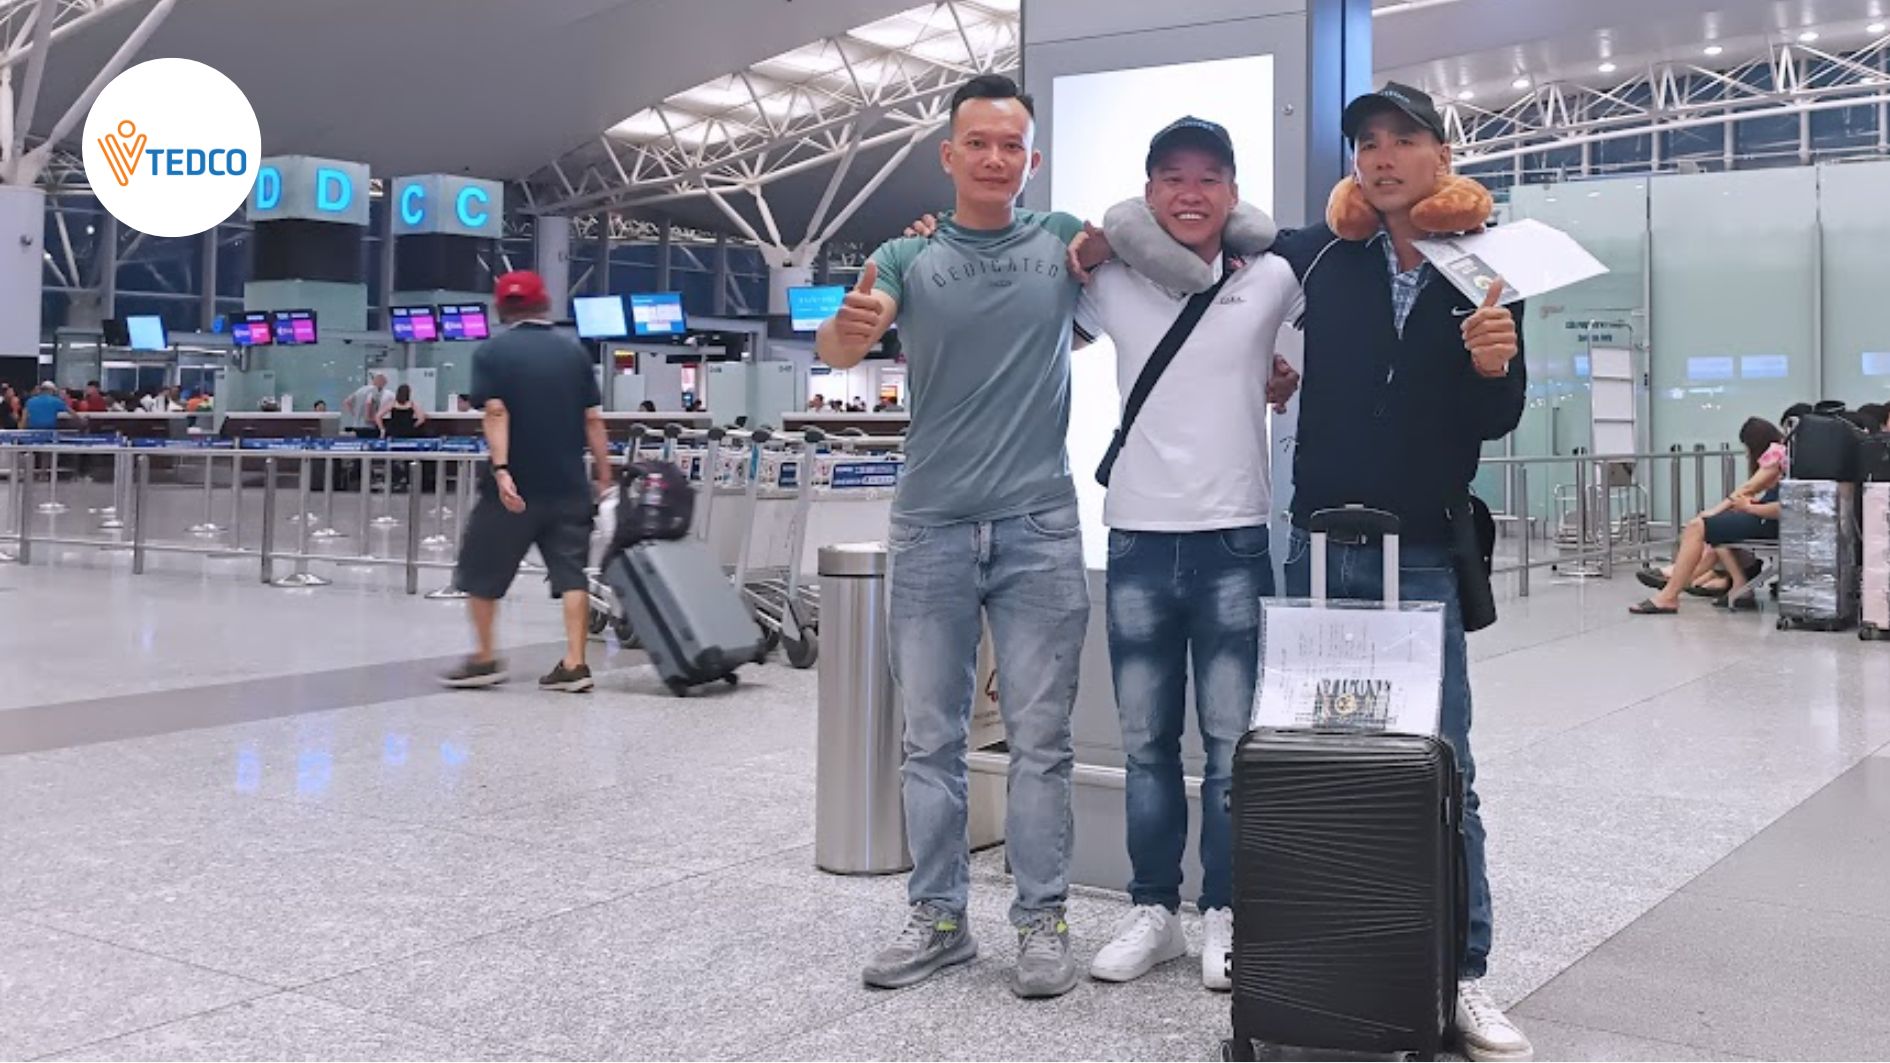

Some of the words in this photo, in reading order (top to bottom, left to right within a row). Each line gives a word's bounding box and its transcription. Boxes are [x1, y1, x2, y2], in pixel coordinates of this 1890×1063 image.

[256, 167, 282, 210] D
[316, 167, 352, 211] D
[401, 184, 425, 225] C
[456, 186, 488, 228] C
[932, 257, 1058, 288] DEDICATED
